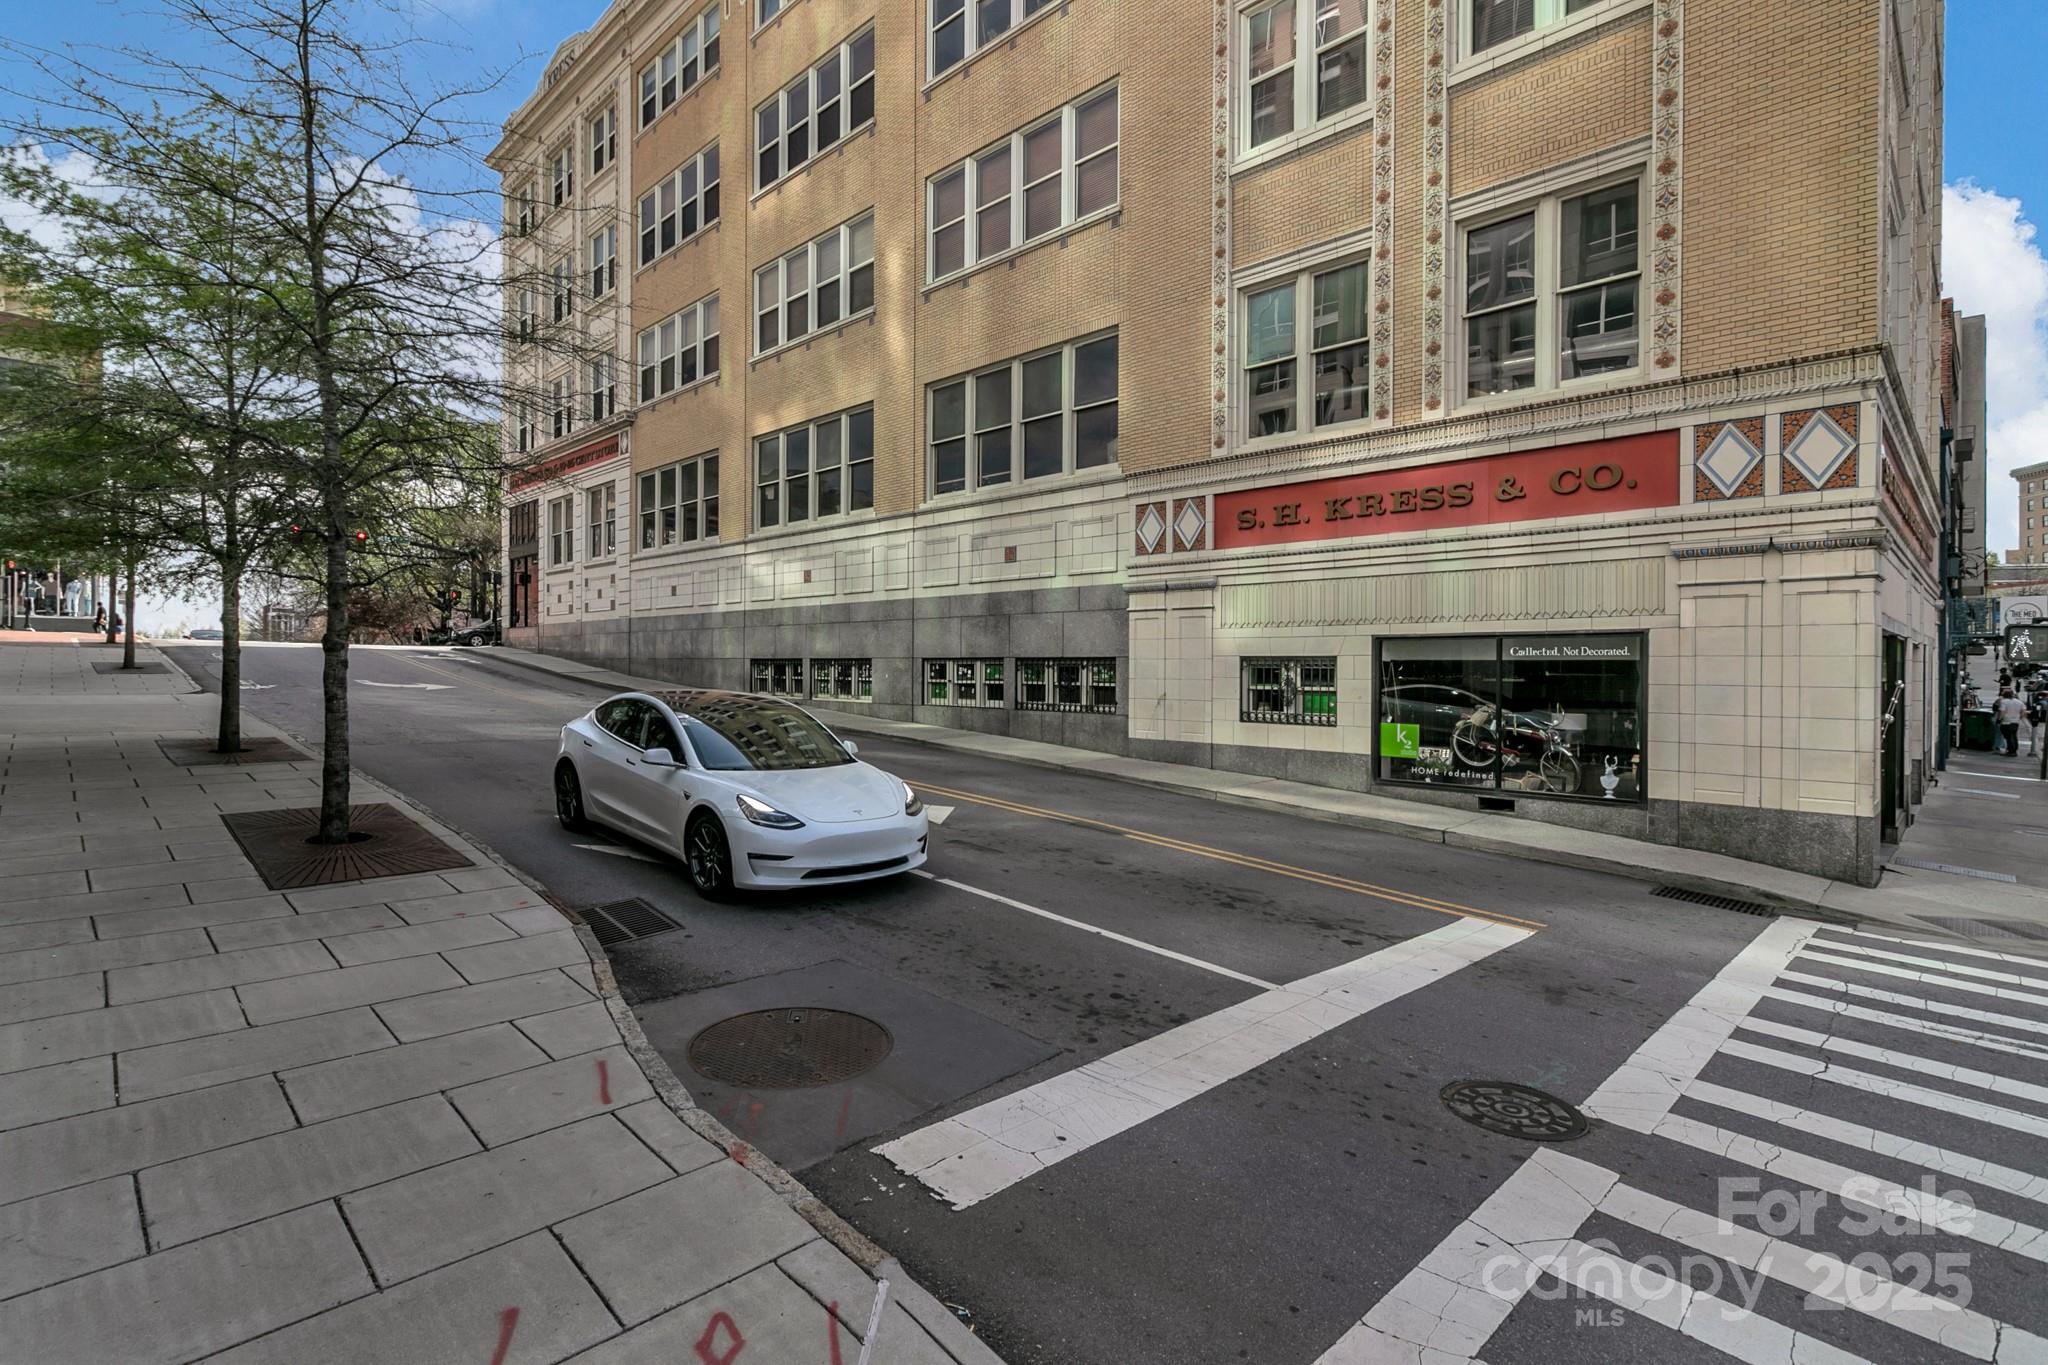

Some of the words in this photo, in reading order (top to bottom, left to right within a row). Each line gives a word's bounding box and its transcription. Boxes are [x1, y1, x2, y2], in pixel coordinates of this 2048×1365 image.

[1325, 481, 1474, 522] KRESS
[1495, 475, 1526, 502] &
[1551, 463, 1638, 495] CO.
[1563, 646, 1580, 656] Not
[1580, 646, 1631, 656] Decorated.
[1411, 766, 1440, 776] HOME
